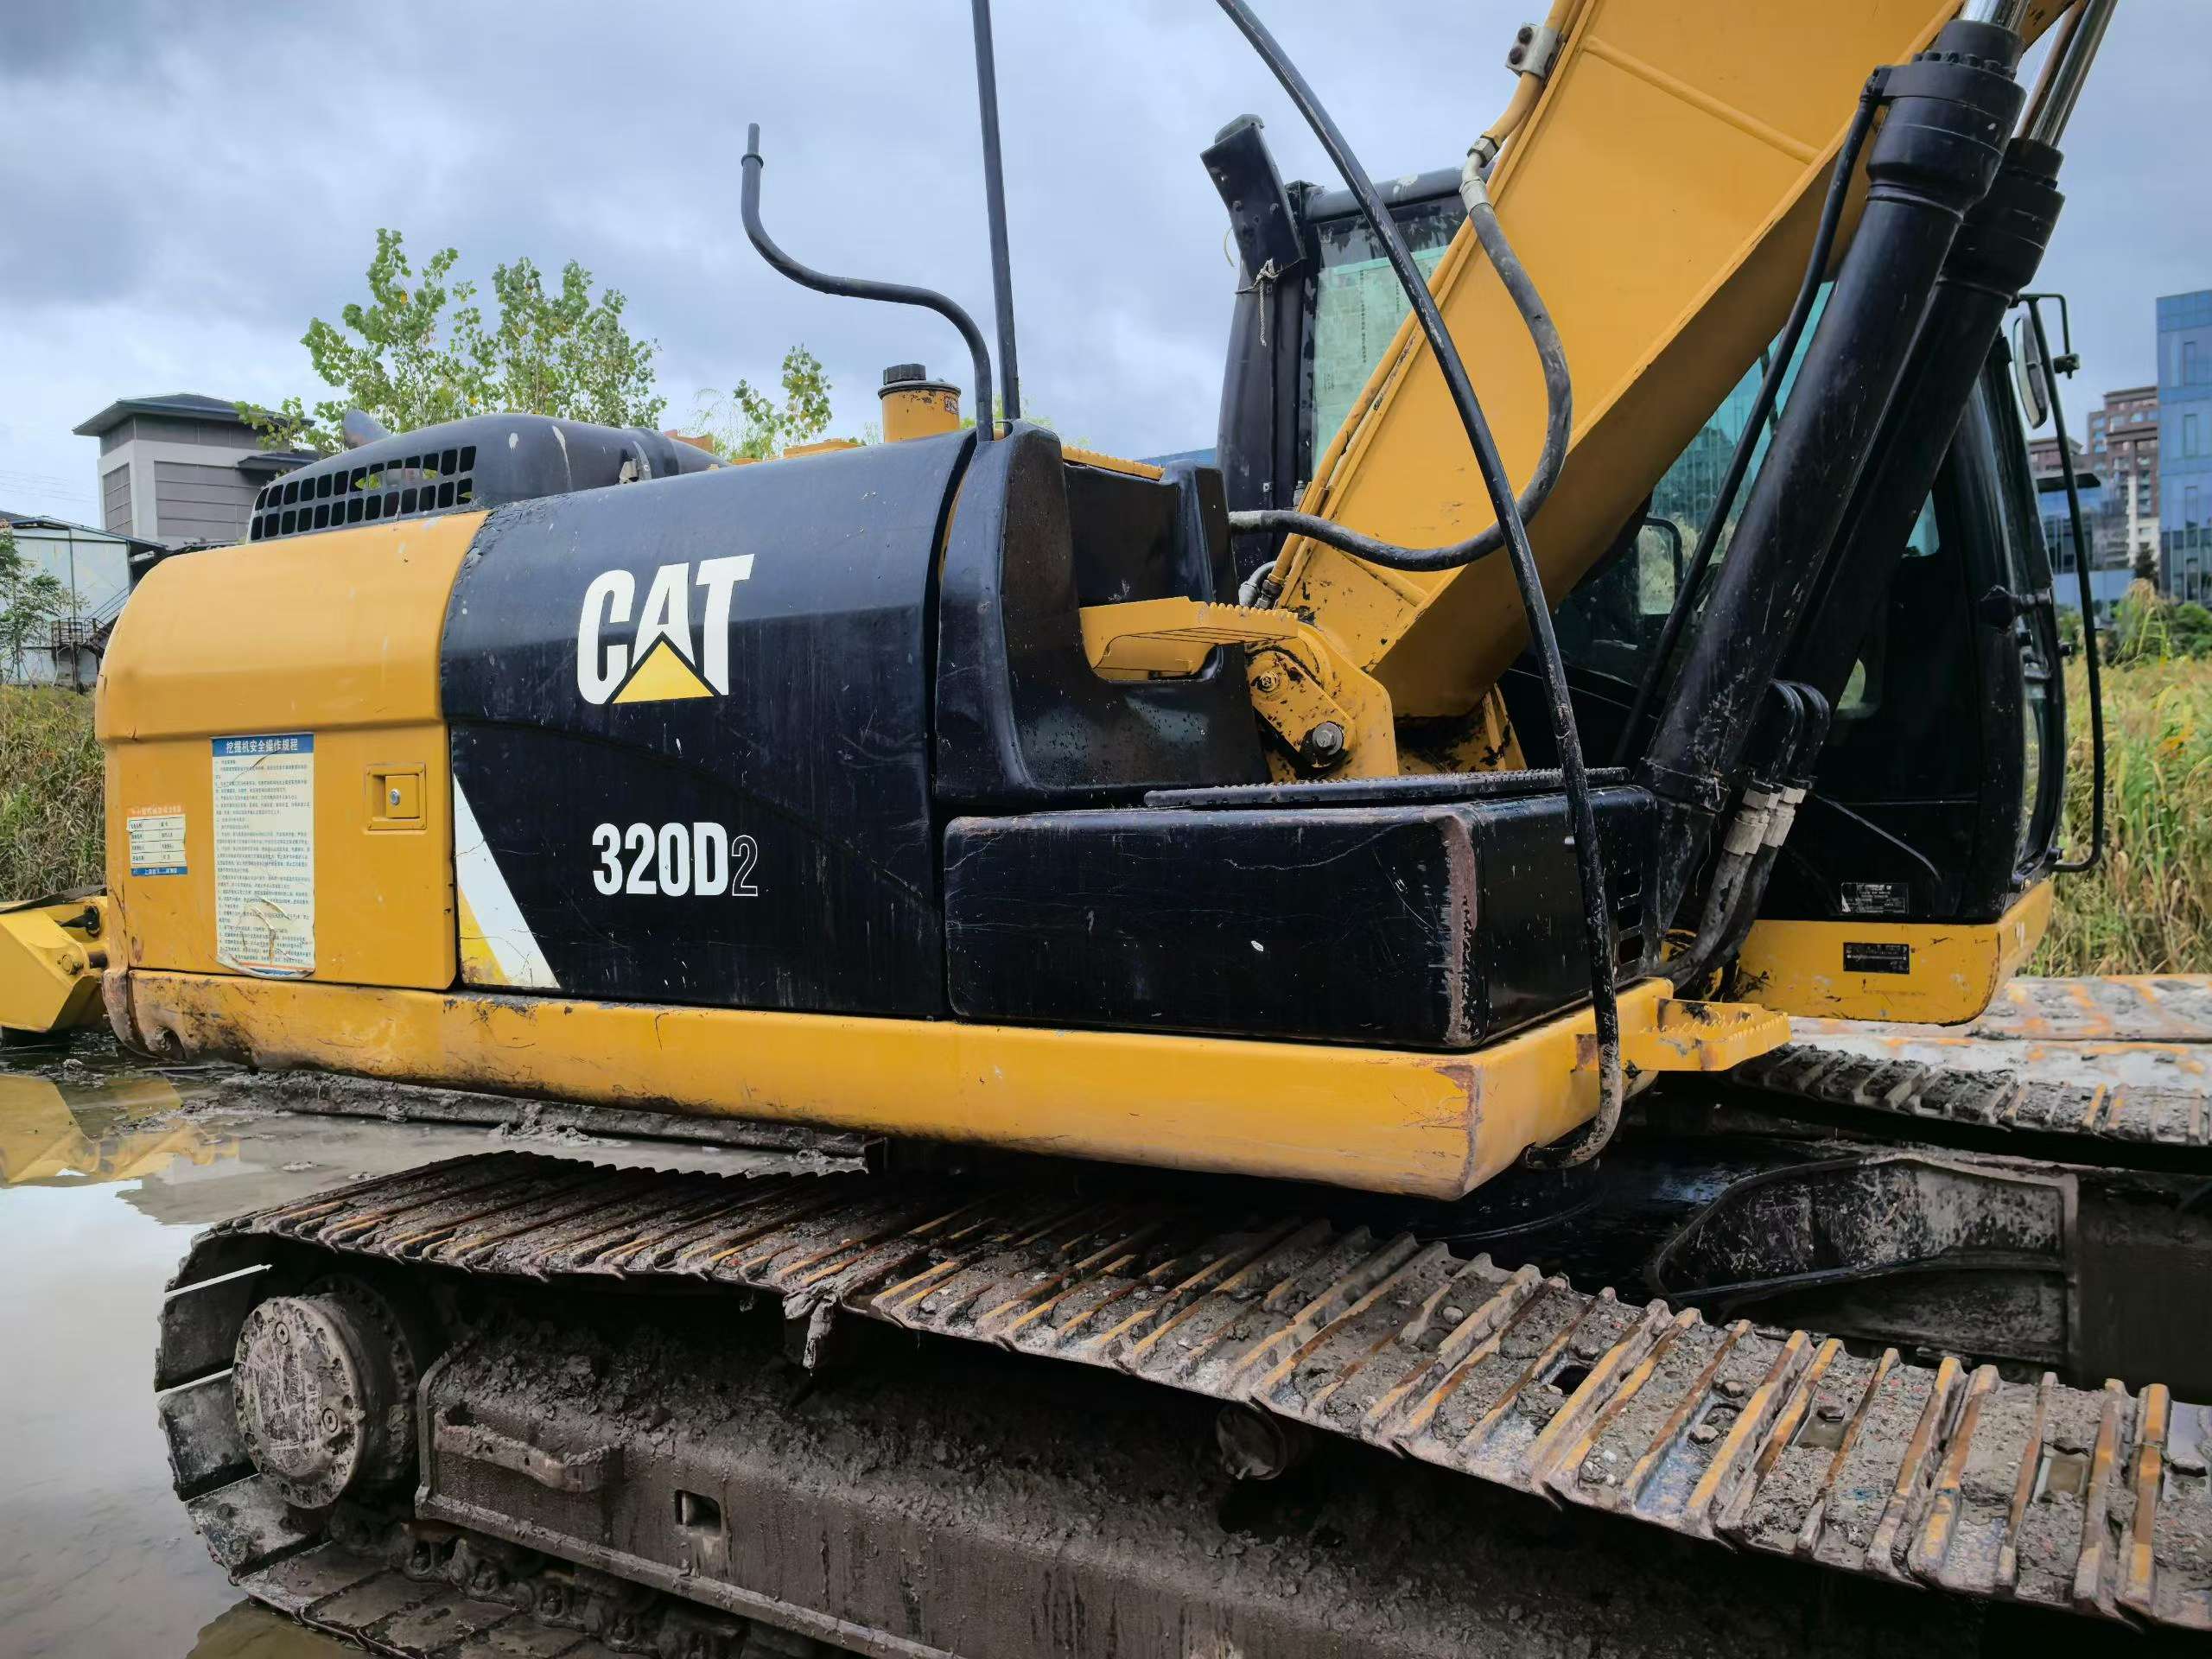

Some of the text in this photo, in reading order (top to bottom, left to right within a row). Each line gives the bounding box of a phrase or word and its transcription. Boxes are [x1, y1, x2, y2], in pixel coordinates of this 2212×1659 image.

[577, 554, 755, 704] CAT
[226, 738, 298, 754] 挖掘机安全操作规程
[592, 822, 759, 897] 320D2
